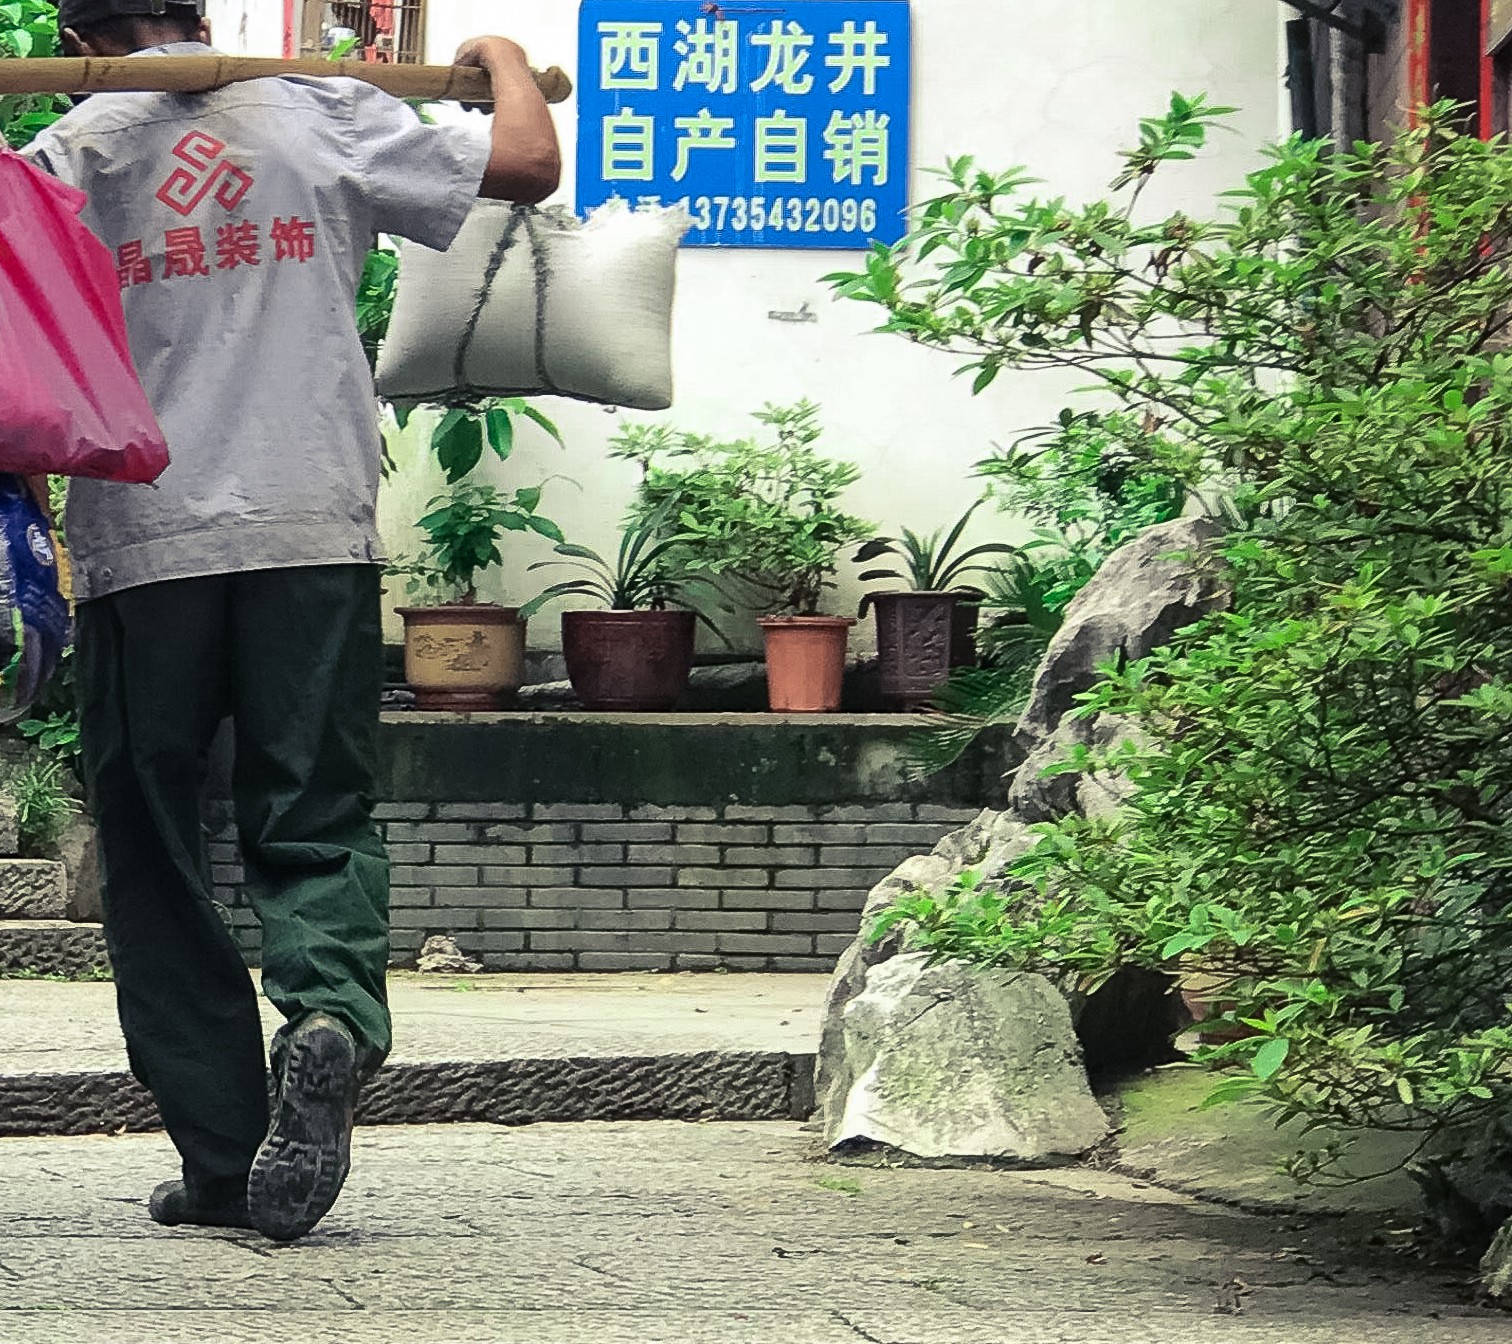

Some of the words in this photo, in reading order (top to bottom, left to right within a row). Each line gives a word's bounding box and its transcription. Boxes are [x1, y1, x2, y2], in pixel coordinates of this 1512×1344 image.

[597, 19, 891, 95] 西湖龙井
[601, 107, 891, 185] 自产自销
